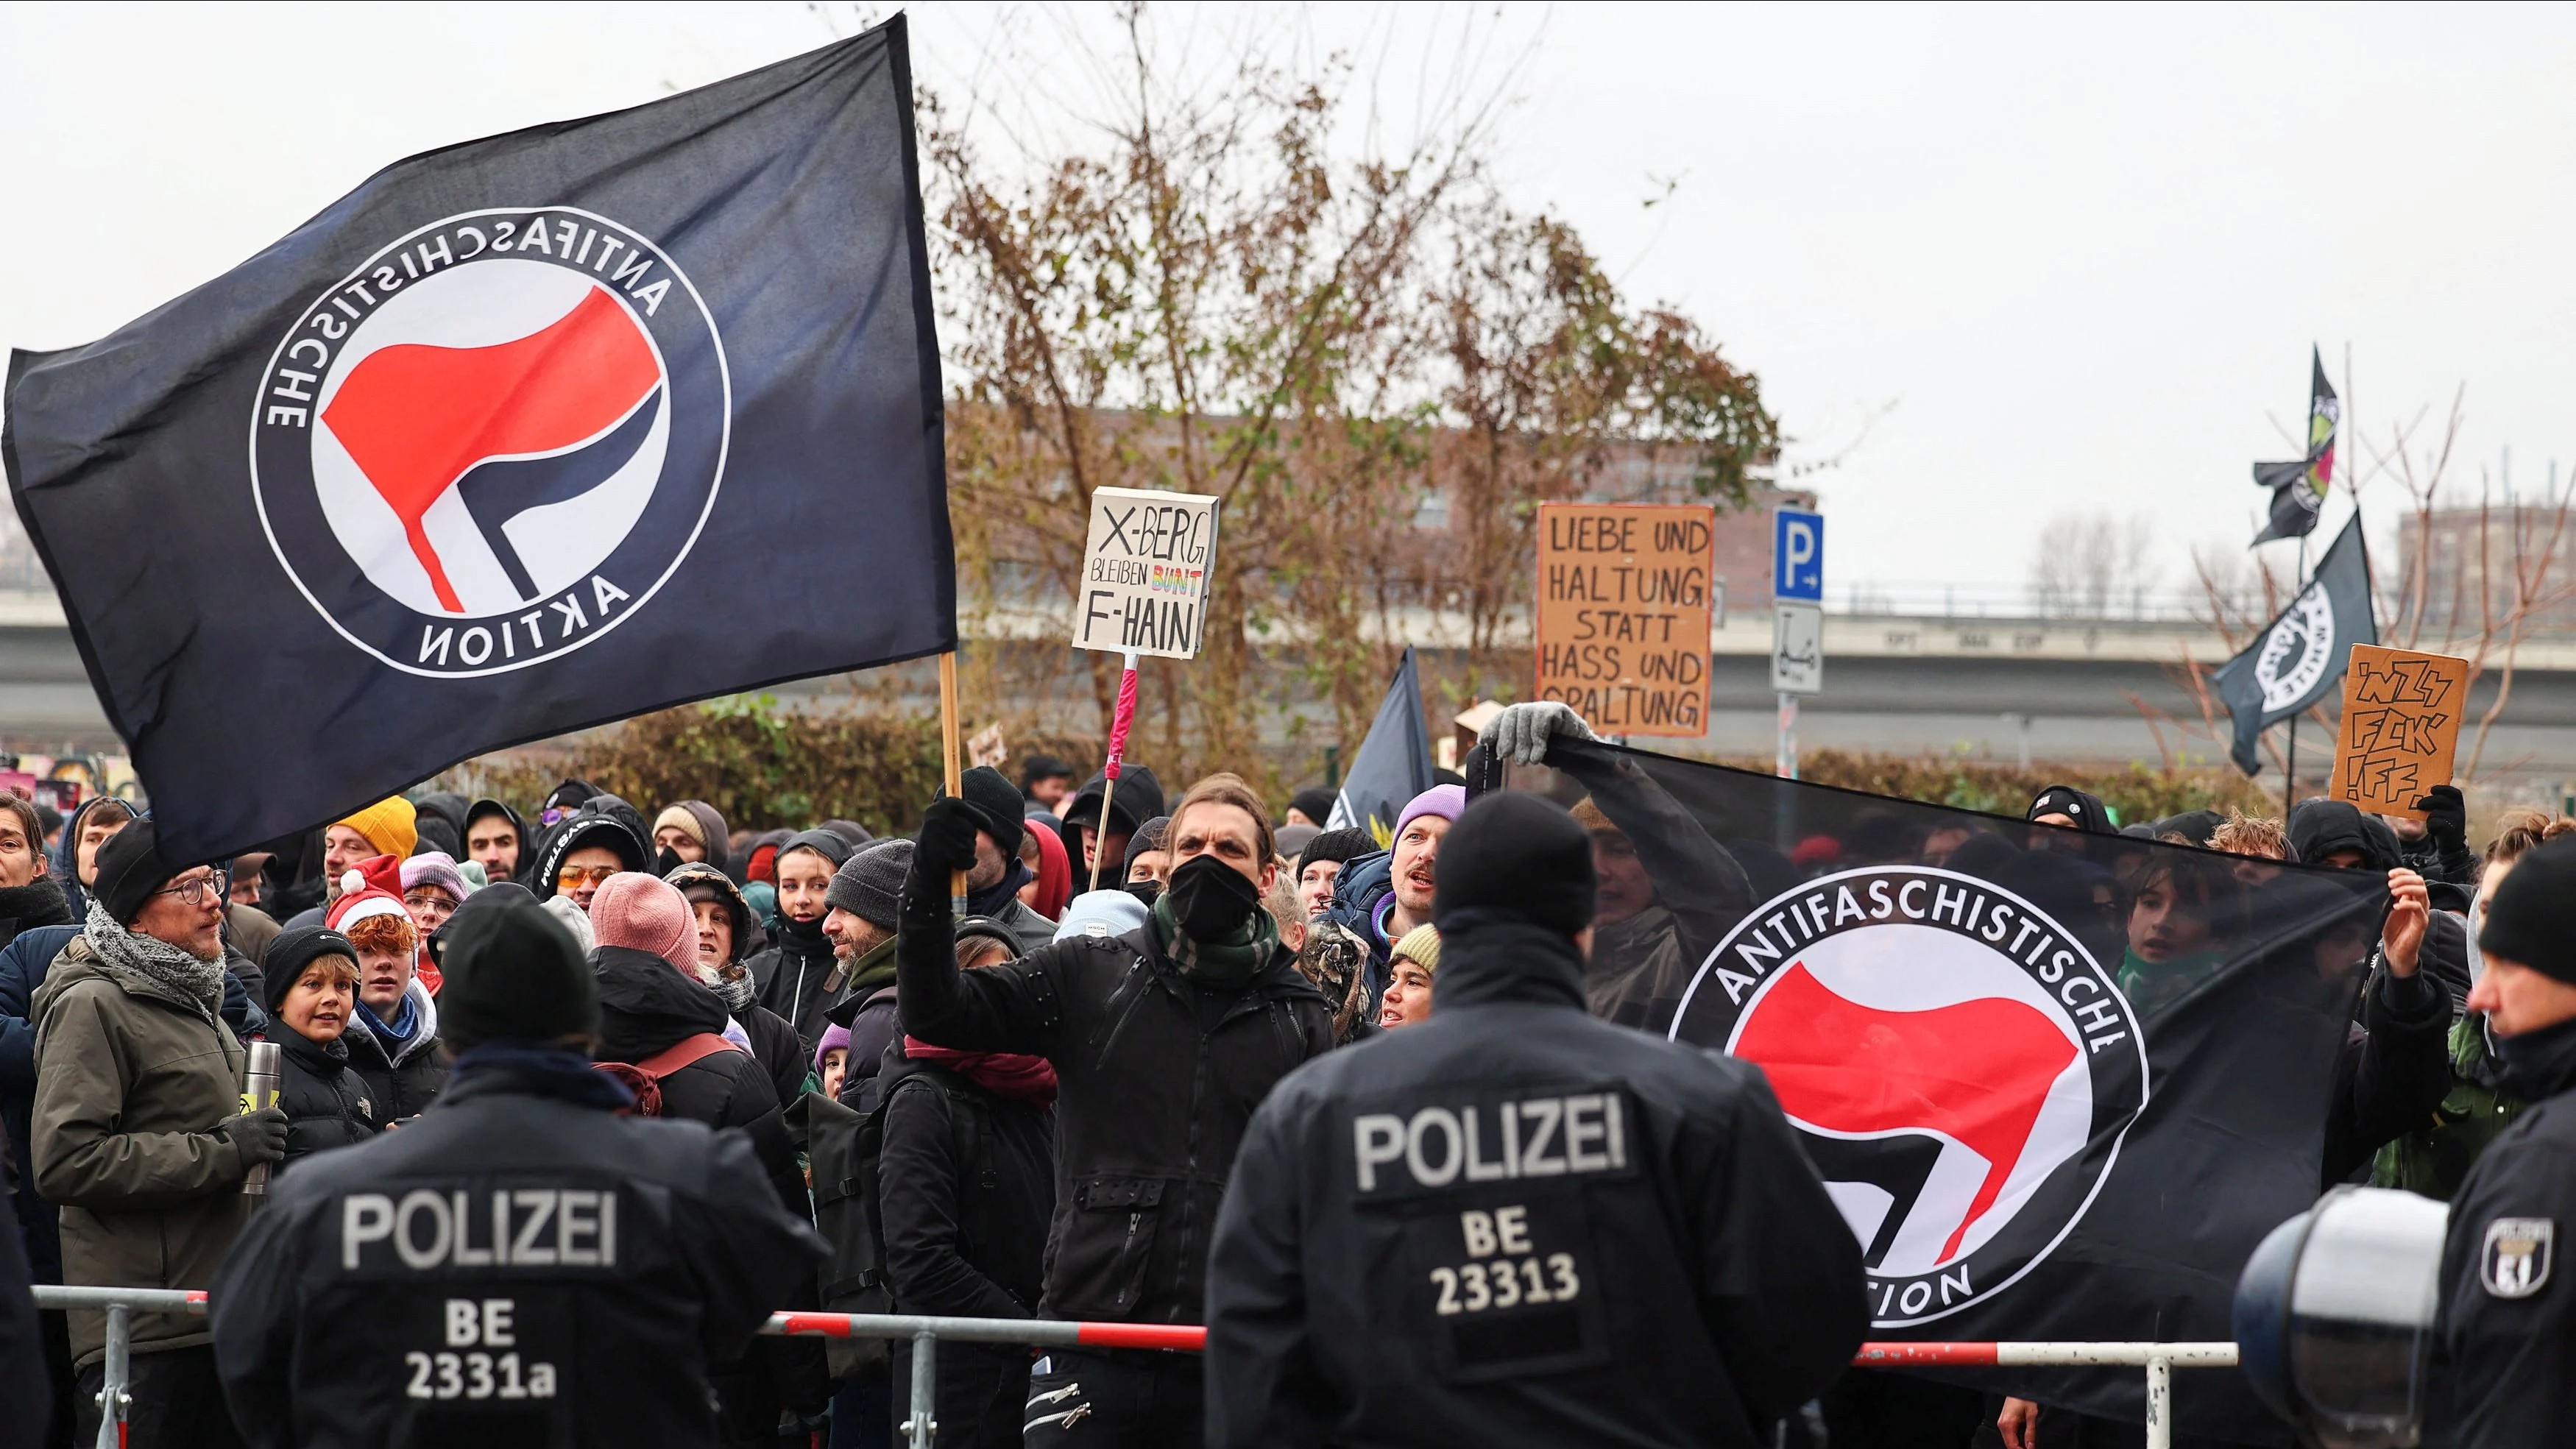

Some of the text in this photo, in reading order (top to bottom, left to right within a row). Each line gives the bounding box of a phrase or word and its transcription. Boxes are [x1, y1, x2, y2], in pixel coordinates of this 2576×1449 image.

[1099, 506, 1209, 564] X-BERG
[1551, 517, 1711, 555] LIEBE UND
[1785, 521, 1814, 589] P
[1091, 558, 1202, 597] BLEIBEN BUNT
[1549, 564, 1704, 607] HALTUNG
[1083, 590, 1194, 652] F-HAIN
[1574, 609, 1677, 642] STATT
[1542, 643, 1702, 686] HASS UND
[1354, 1092, 1627, 1192] POLIZEI
[342, 1188, 617, 1270] POLIZEI
[1461, 1205, 1533, 1258] BE
[1429, 1253, 1580, 1316] 23313
[445, 1298, 516, 1347] BE
[404, 1351, 557, 1399] 2331a
